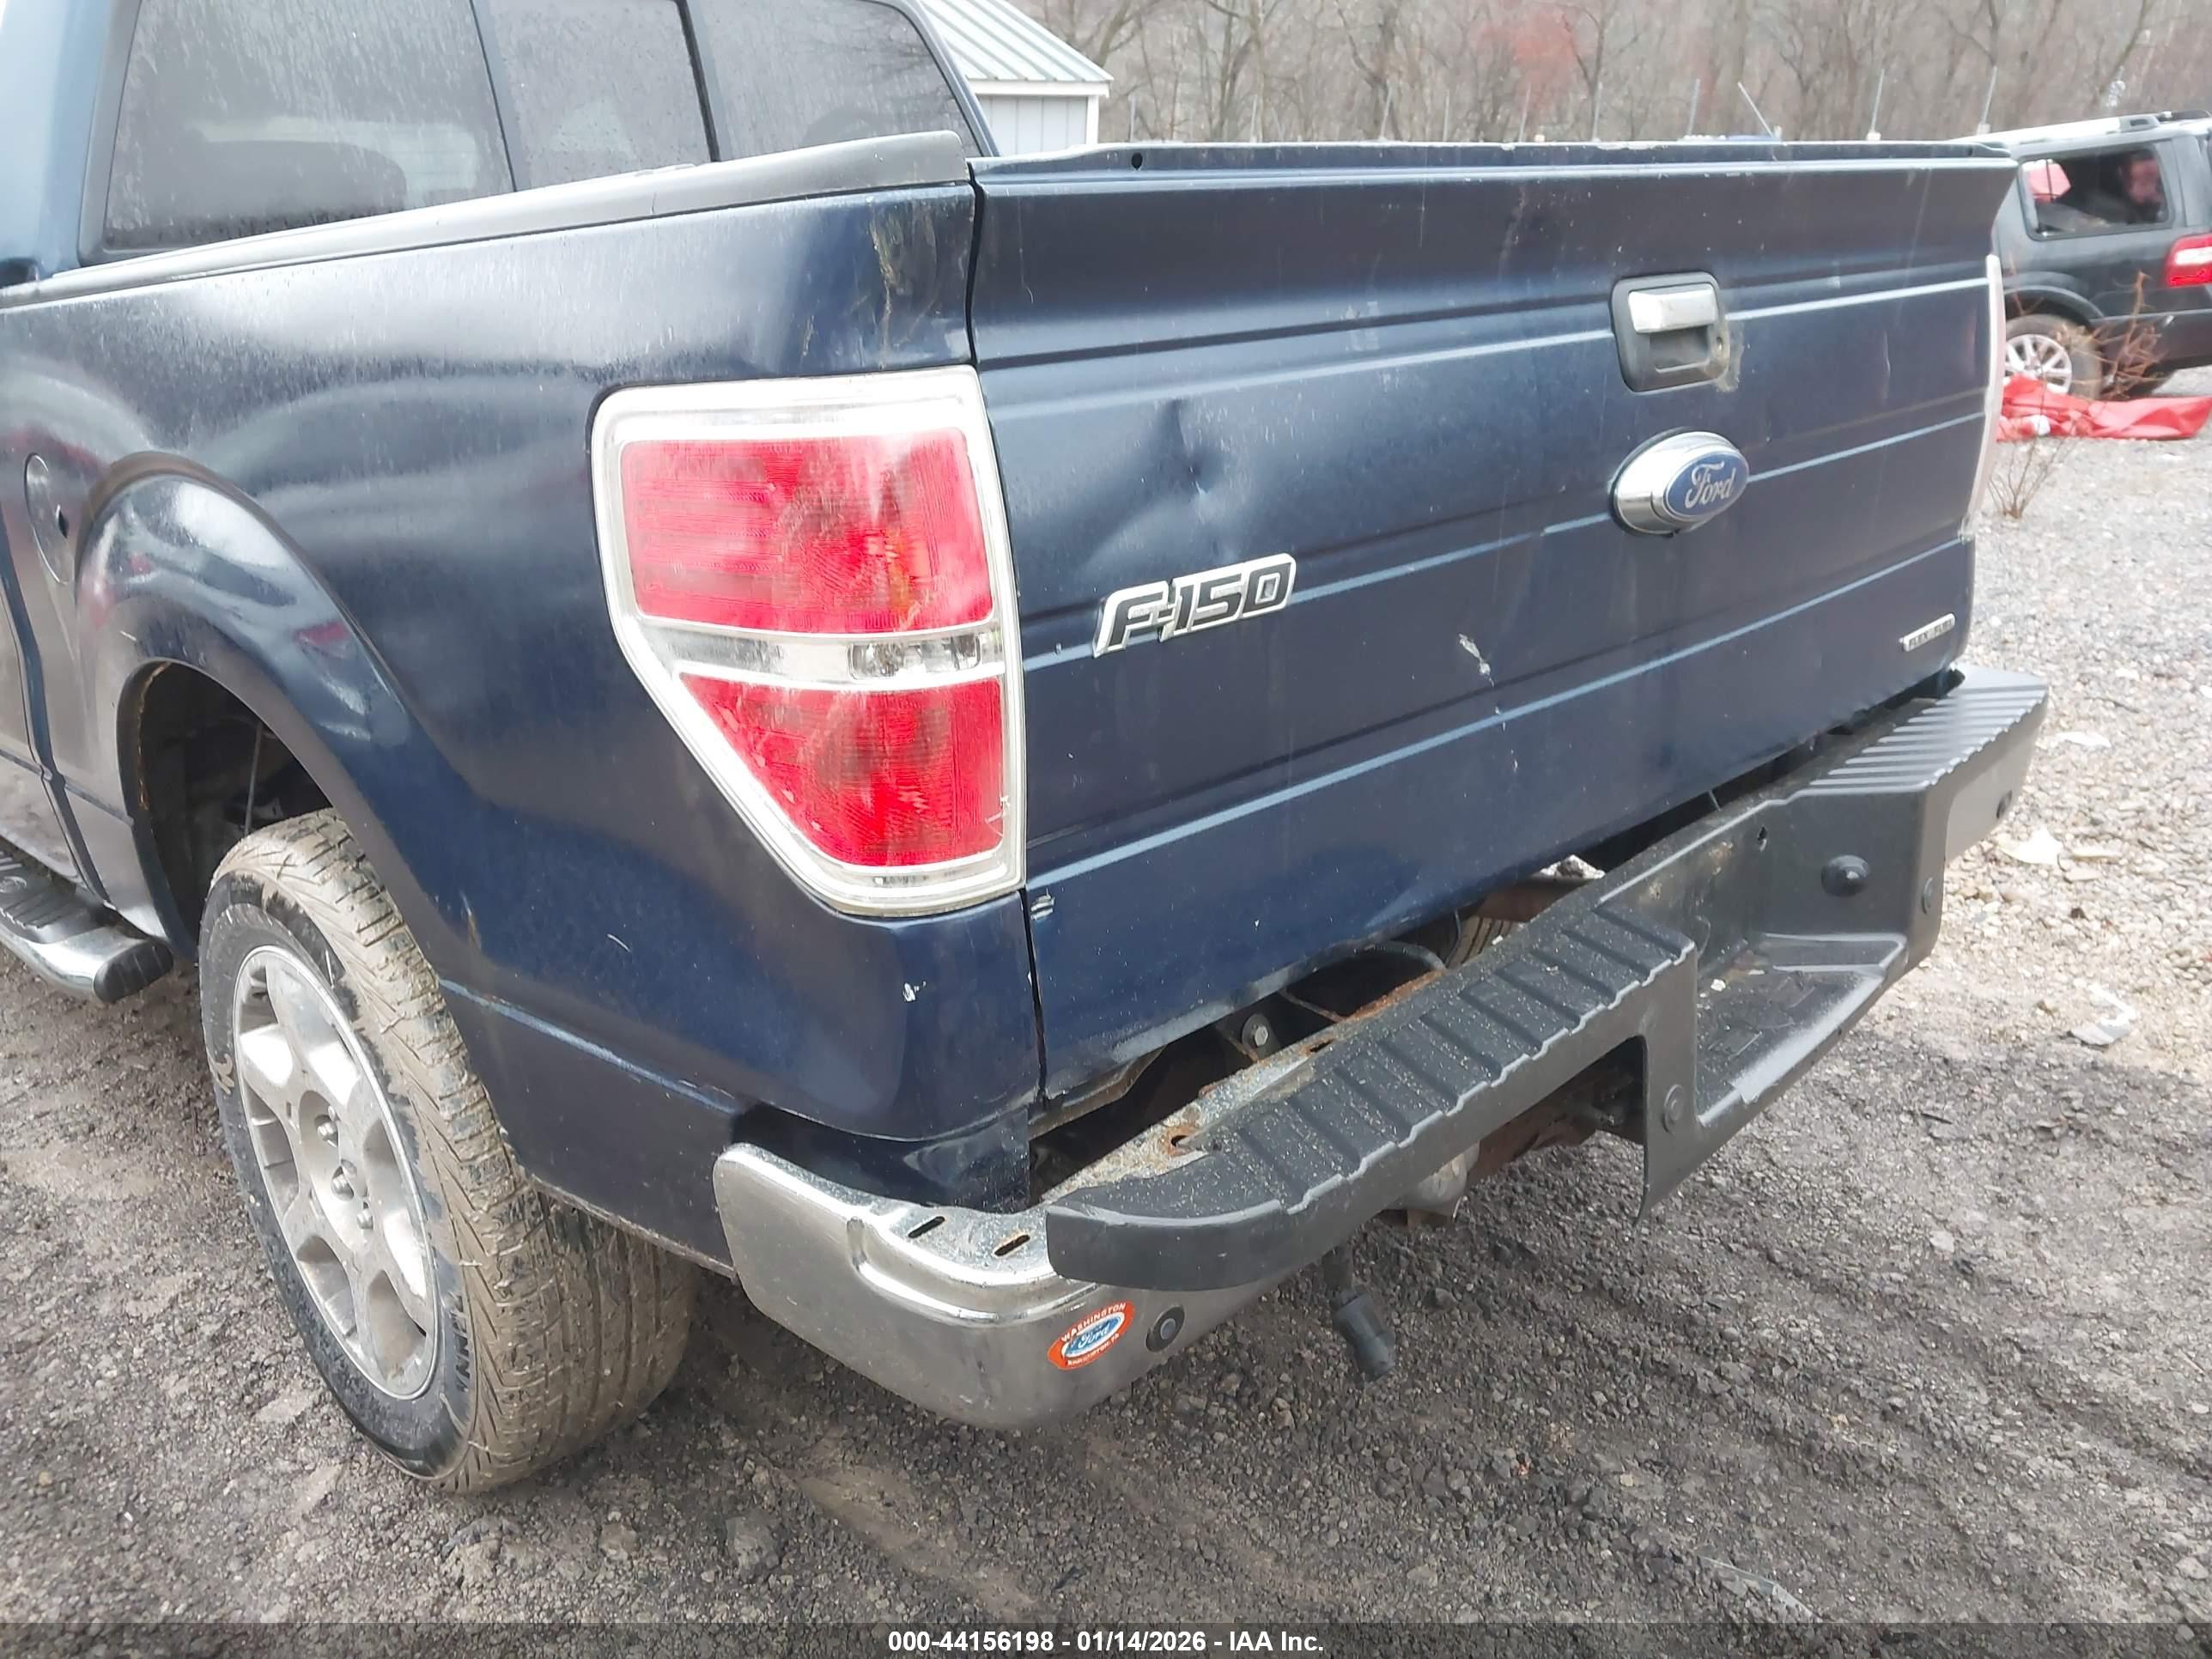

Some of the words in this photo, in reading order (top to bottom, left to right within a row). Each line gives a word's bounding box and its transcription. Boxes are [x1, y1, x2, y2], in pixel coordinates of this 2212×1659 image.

[1685, 460, 1736, 508] Ford
[1092, 552, 1297, 659] F-150
[1060, 1302, 1127, 1342] WASHINGTON
[1077, 1321, 1110, 1349] Ford
